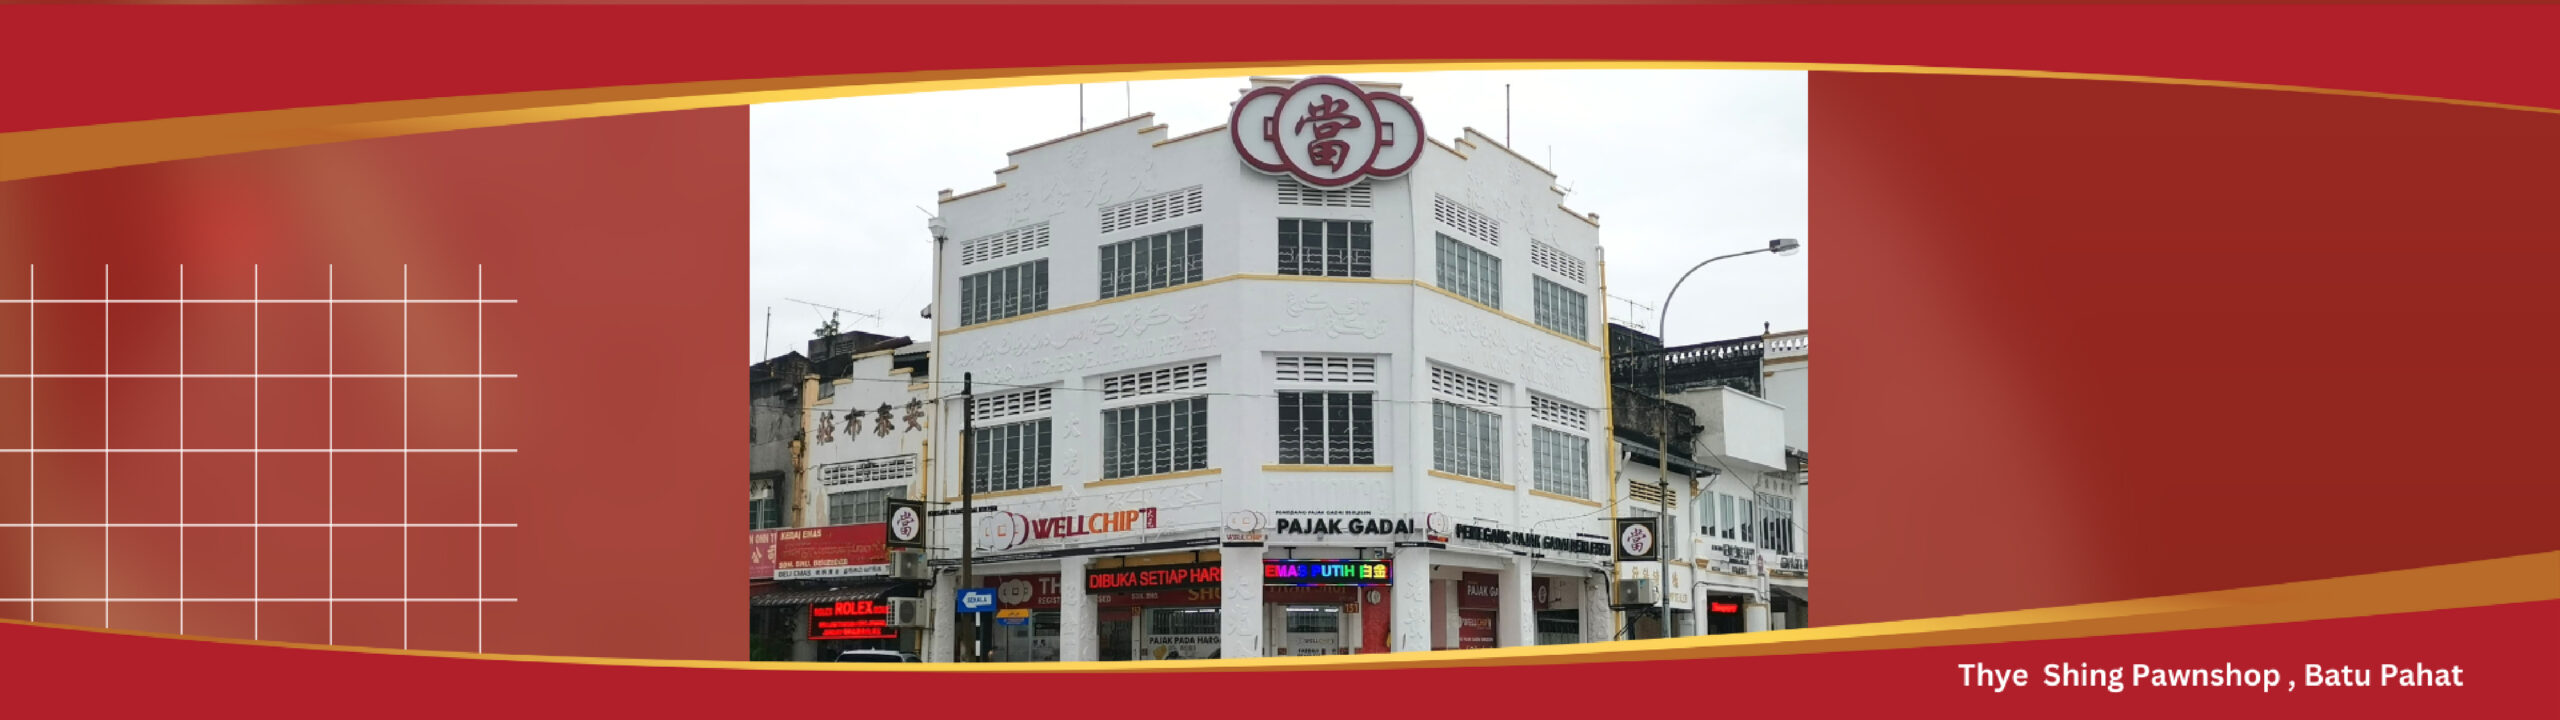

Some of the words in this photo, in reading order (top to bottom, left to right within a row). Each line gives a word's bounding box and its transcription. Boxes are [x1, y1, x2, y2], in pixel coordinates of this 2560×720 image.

[1294, 94, 1361, 173] 當
[1032, 509, 1140, 539] WELLCHIP
[1277, 518, 1343, 535] PAJAK
[1349, 518, 1414, 535] GADAI
[1089, 571, 1137, 589] DIBUKA
[1140, 568, 1188, 587] SETIAP
[1265, 565, 1307, 578] EMAS
[1311, 565, 1355, 578] PUTIH
[835, 600, 874, 616] ROLEX
